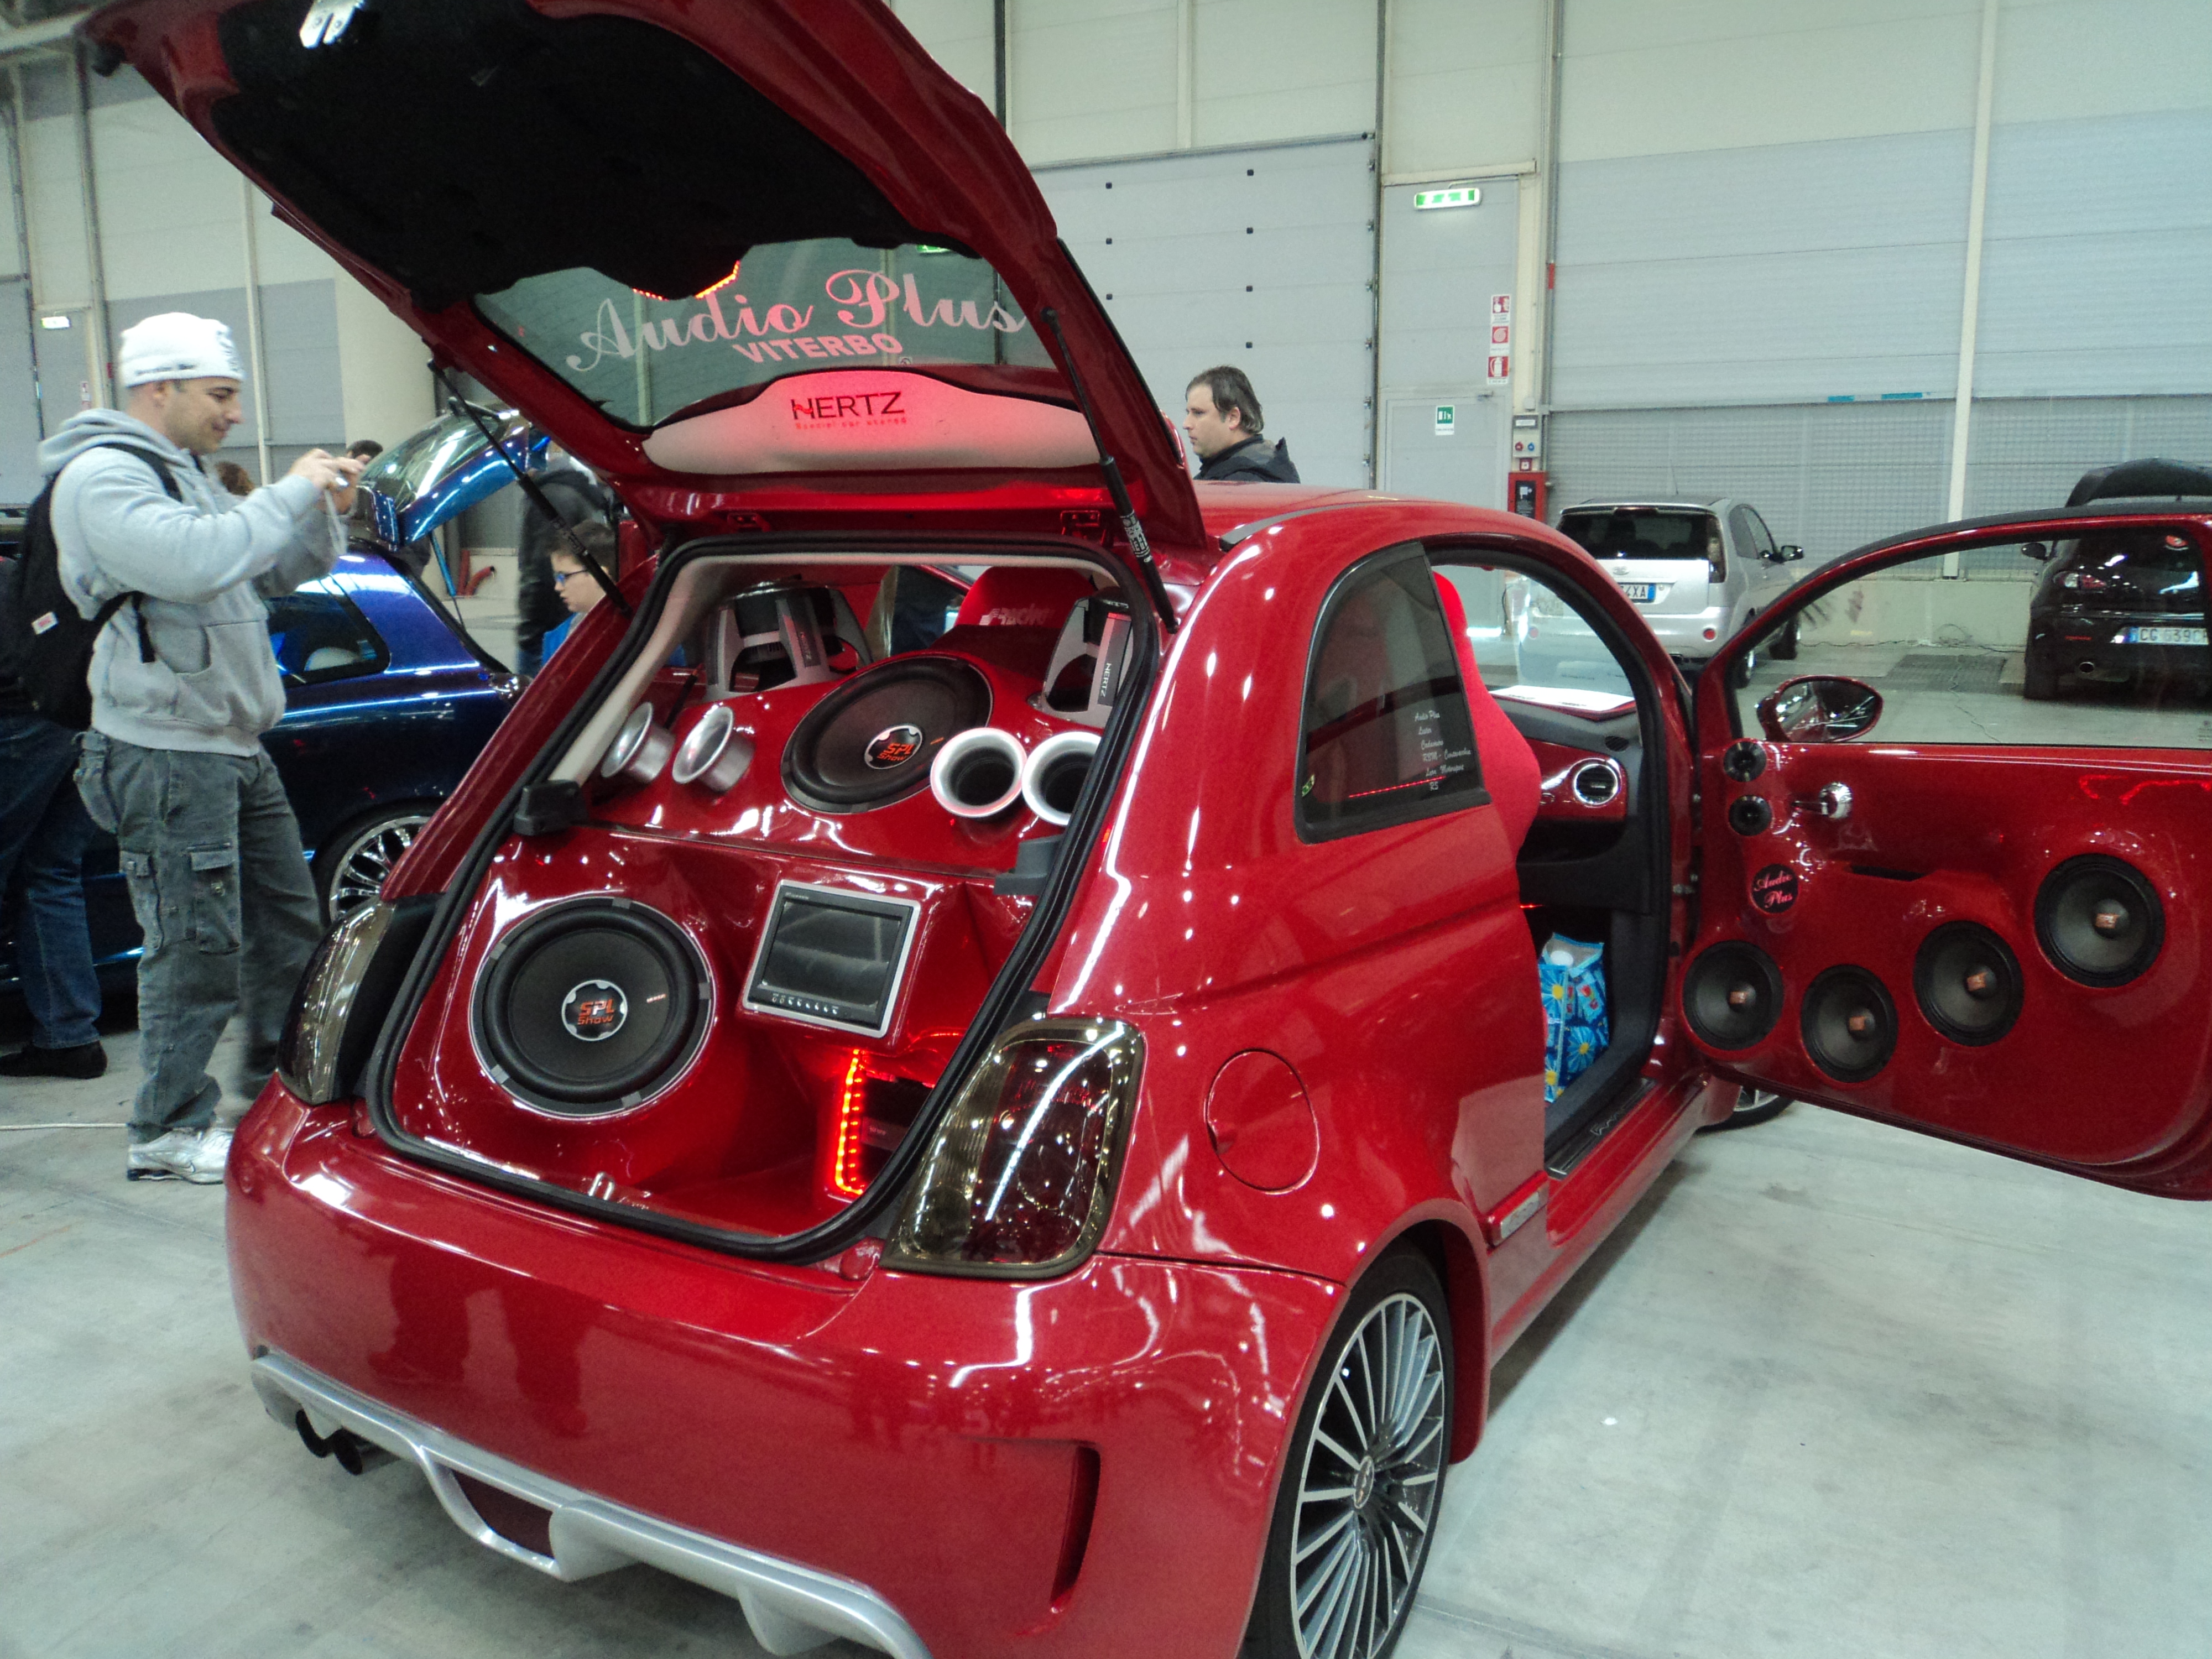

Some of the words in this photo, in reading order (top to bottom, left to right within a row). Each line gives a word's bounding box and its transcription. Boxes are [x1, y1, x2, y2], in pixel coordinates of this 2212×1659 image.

[566, 291, 813, 372] Audio
[826, 269, 1026, 332] Plus
[732, 333, 902, 363] VITERBO
[791, 391, 905, 420] HERTZ
[877, 753, 907, 762] Show
[884, 742, 915, 755] SPL
[1754, 870, 1793, 891] Audio
[1764, 890, 1793, 909] Plus
[579, 998, 615, 1016] SPL
[577, 1015, 614, 1025] Show
